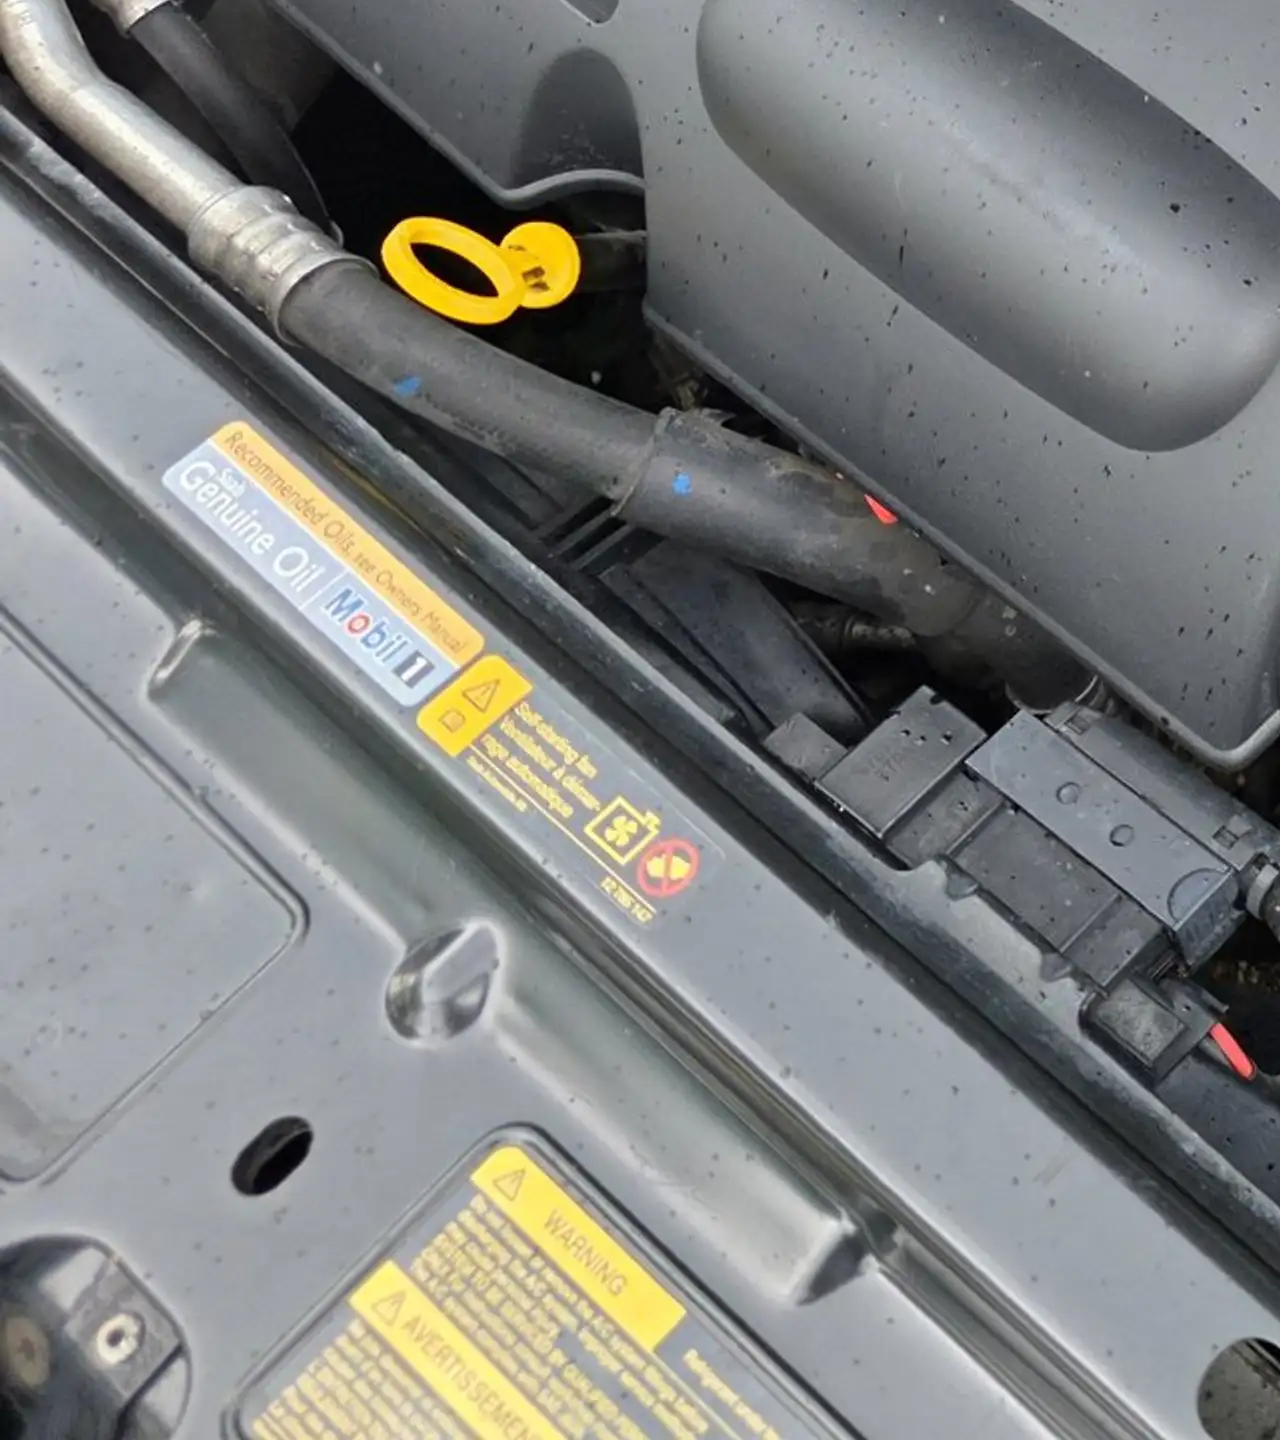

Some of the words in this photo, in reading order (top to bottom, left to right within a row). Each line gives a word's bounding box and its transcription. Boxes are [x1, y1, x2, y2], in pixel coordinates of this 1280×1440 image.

[180, 462, 276, 555] Genuine
[272, 545, 324, 593] Oil
[225, 430, 328, 525] Recommended
[421, 610, 468, 654] Manual
[324, 588, 408, 662] Mobil
[544, 1211, 630, 1297] WARNING
